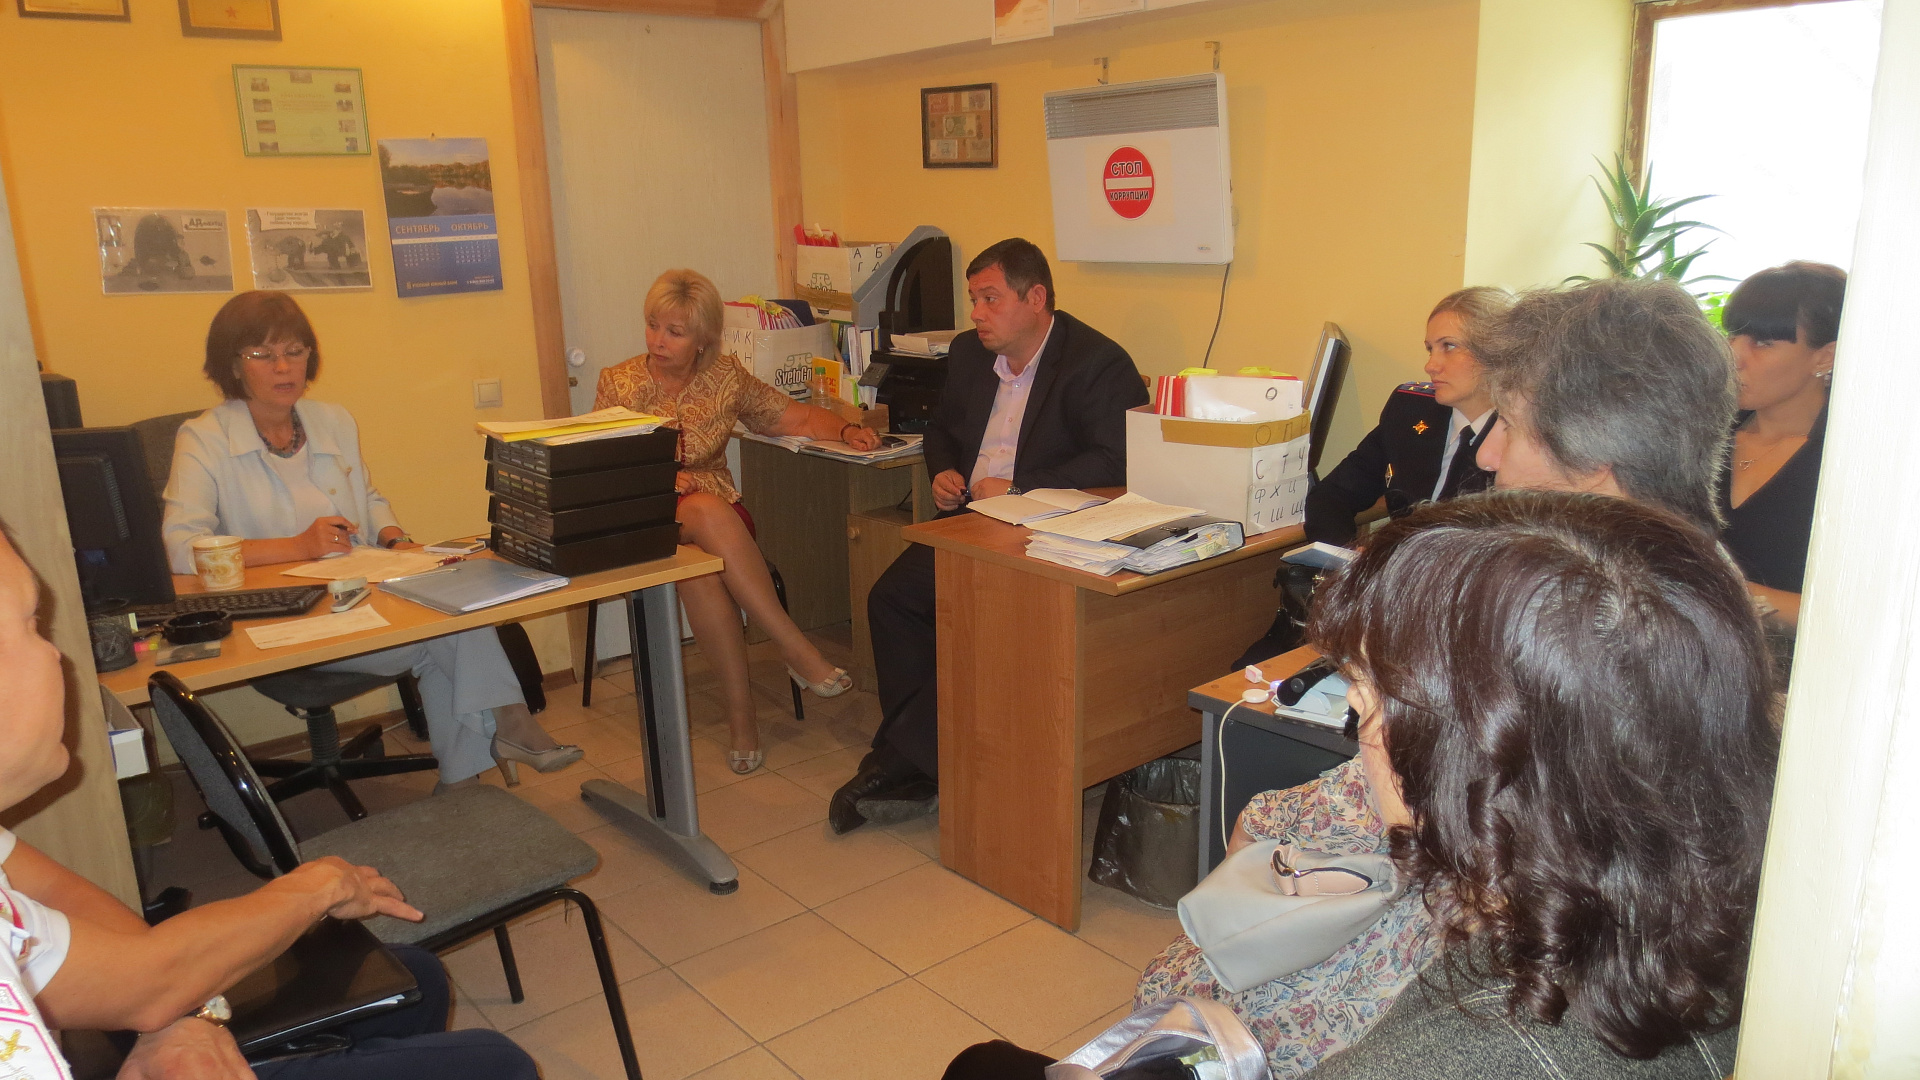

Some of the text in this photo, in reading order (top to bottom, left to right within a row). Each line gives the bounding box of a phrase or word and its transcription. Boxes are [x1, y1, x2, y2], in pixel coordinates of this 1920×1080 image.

[1111, 161, 1142, 176] СТОП
[1109, 190, 1149, 201] КОРРУПЦИИ
[395, 222, 489, 234] СЕНТЯБРЬ ОКТЯБРЬ
[853, 247, 862, 259] А
[875, 246, 883, 259] Б
[857, 261, 864, 273] Г
[744, 330, 752, 345] К
[744, 351, 752, 363] Н
[1255, 424, 1272, 446] О
[1255, 446, 1306, 480] С Т У
[1254, 479, 1297, 504] Ф Х Ц
[1270, 506, 1284, 523] Ш
